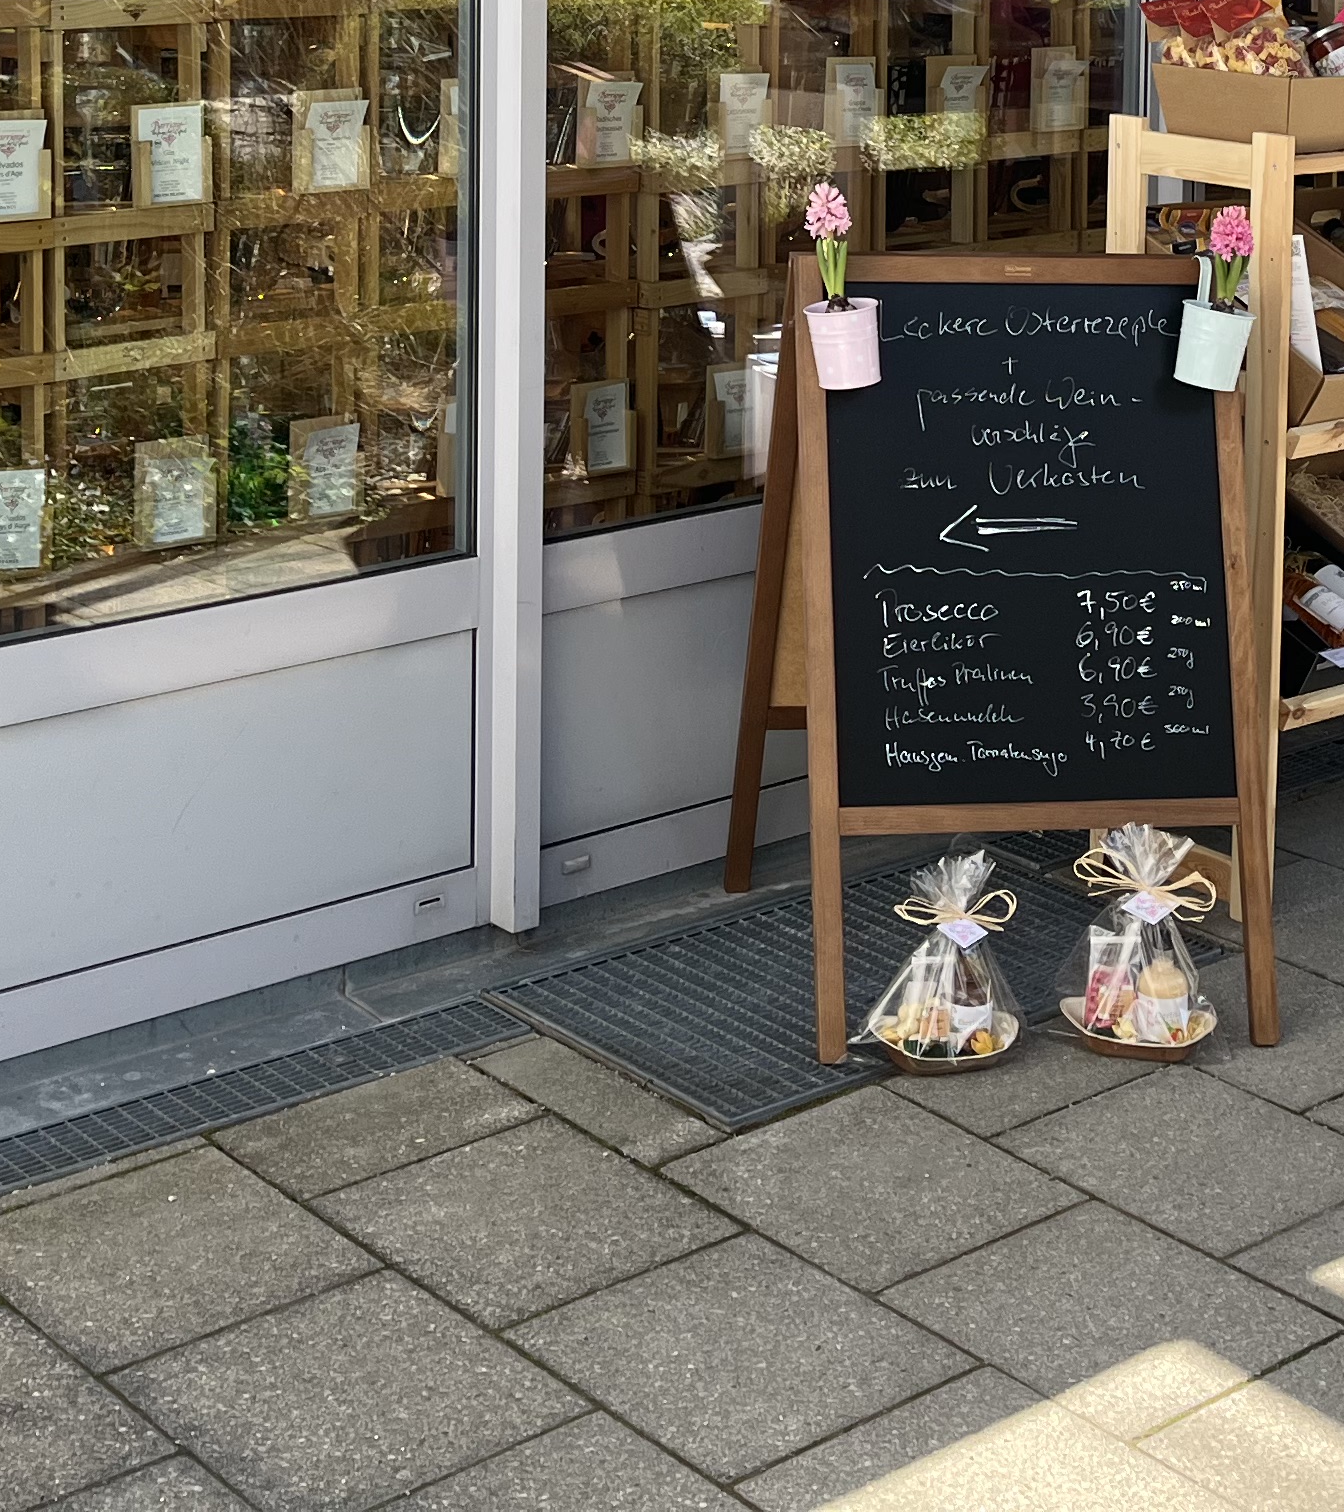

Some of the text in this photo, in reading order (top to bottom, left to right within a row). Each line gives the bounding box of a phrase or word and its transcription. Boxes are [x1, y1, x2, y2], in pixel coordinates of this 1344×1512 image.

[880, 299, 999, 341] Leckere
[1001, 356, 1019, 375] +
[916, 383, 1036, 431] passende
[971, 420, 1097, 469] vorschläge
[901, 462, 1147, 496] zum Verkosten
[875, 588, 999, 628] Prosecco
[1076, 590, 1156, 620] 7,50€
[883, 633, 1002, 658] Eierlikör
[1075, 621, 1155, 651] 6,90€
[951, 661, 1035, 686] Pralinen
[1078, 652, 1158, 684] 6,90€
[1079, 693, 1159, 724] 3,90€
